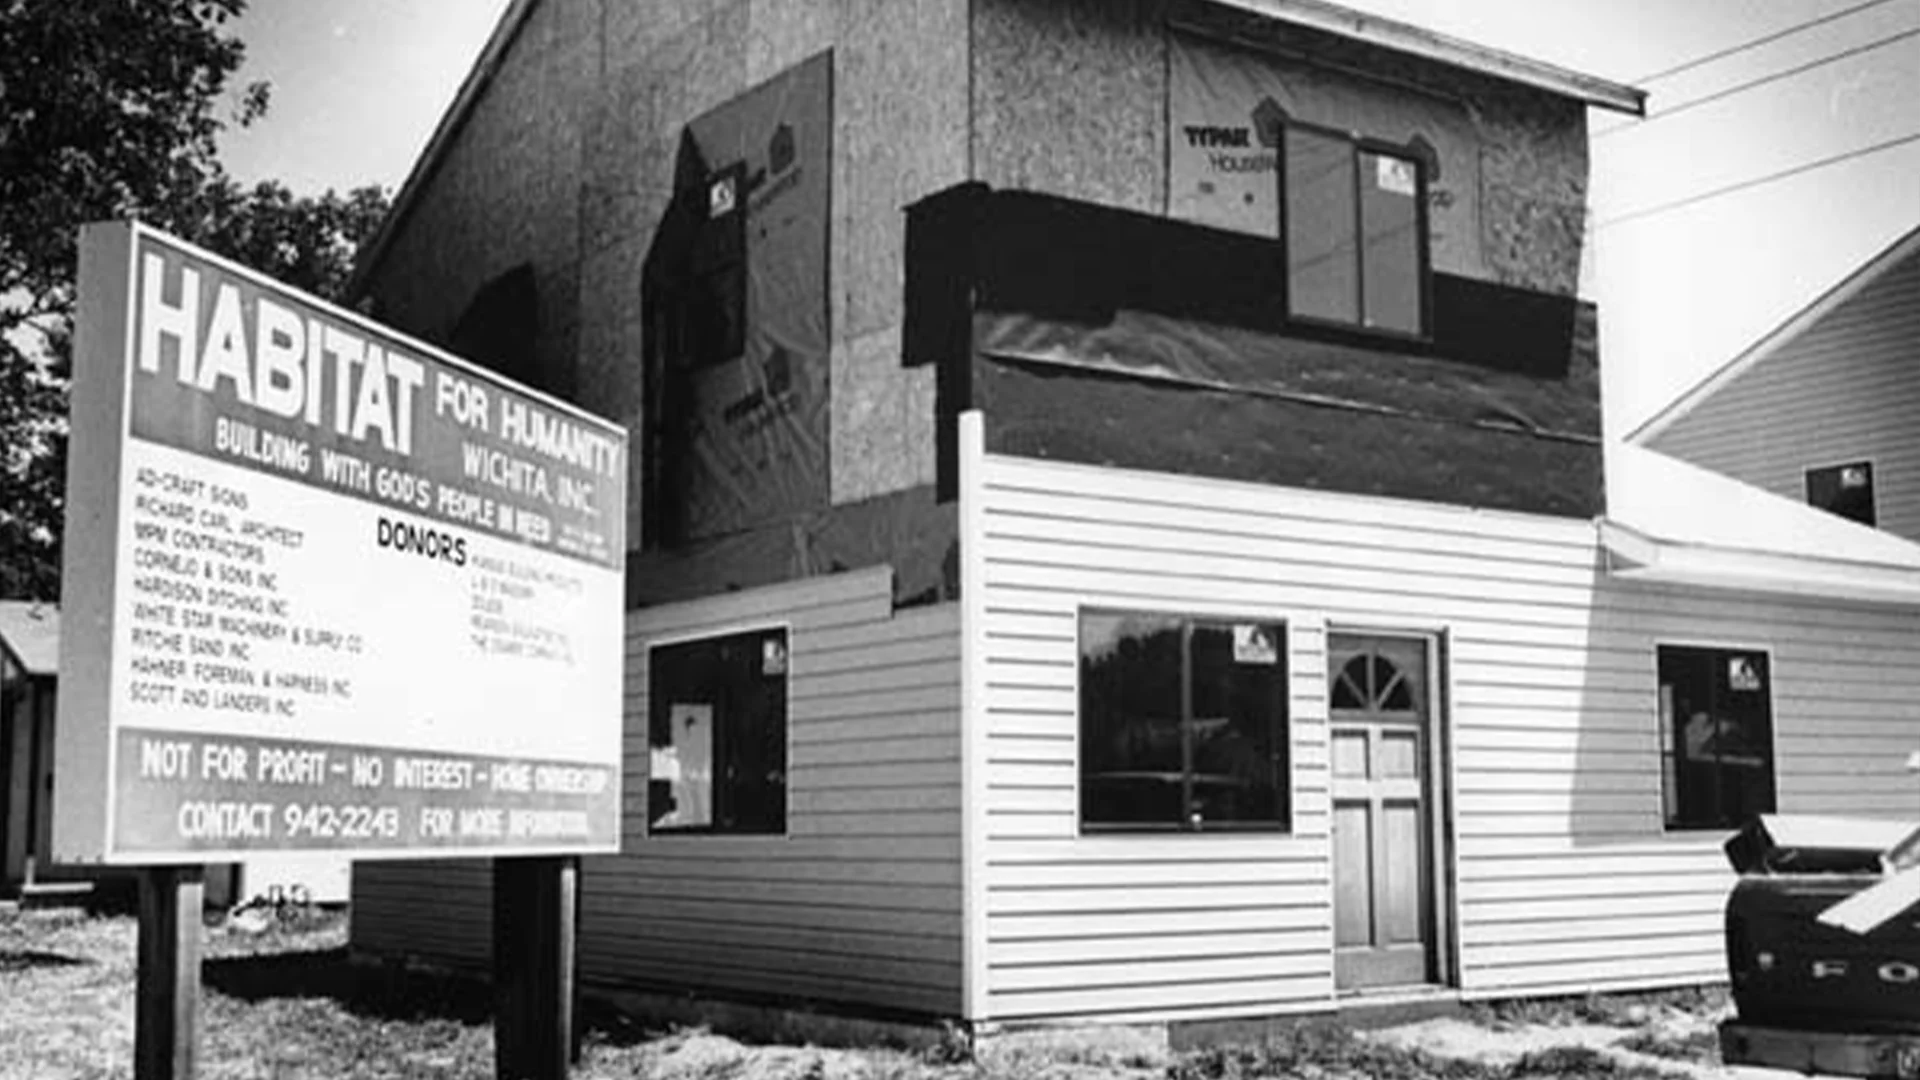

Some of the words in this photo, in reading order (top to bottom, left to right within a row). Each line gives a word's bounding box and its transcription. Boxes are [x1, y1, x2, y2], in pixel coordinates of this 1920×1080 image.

[139, 252, 424, 456] HABITAT
[436, 371, 488, 432] FOR
[501, 397, 620, 478] HUMANITY
[215, 417, 309, 474] BUILDING
[320, 448, 371, 493] WITH
[375, 467, 431, 509] GOD'S
[437, 484, 494, 528] PEOPLE
[499, 503, 514, 533] IN
[516, 508, 550, 543] NEED
[135, 495, 193, 524] RICHARD
[240, 520, 303, 547] ARCHITECT
[377, 517, 467, 566] DONORS
[134, 547, 198, 577] CORNEJO
[204, 560, 212, 578] &
[219, 563, 252, 587] SONS
[173, 528, 264, 564] CONTRACTORS
[134, 602, 175, 627] WHITE
[182, 607, 213, 628] STAR
[219, 616, 286, 640] MACHINERY
[292, 626, 299, 645] &
[304, 627, 343, 651] SUPPLY
[189, 635, 224, 657] SAND
[130, 681, 175, 703] SCOTT
[182, 688, 208, 708] AND
[194, 661, 254, 686] FOREMAN
[263, 670, 271, 687] &
[141, 739, 191, 779] NOT
[203, 744, 248, 780] FOR
[258, 747, 326, 784] PROFIT
[352, 754, 382, 786] NO
[394, 757, 473, 789] INTEREST
[178, 801, 273, 838] CONTACT
[284, 803, 399, 838] 942-2243
[419, 807, 453, 837] FOR
[458, 808, 503, 836] MORE
